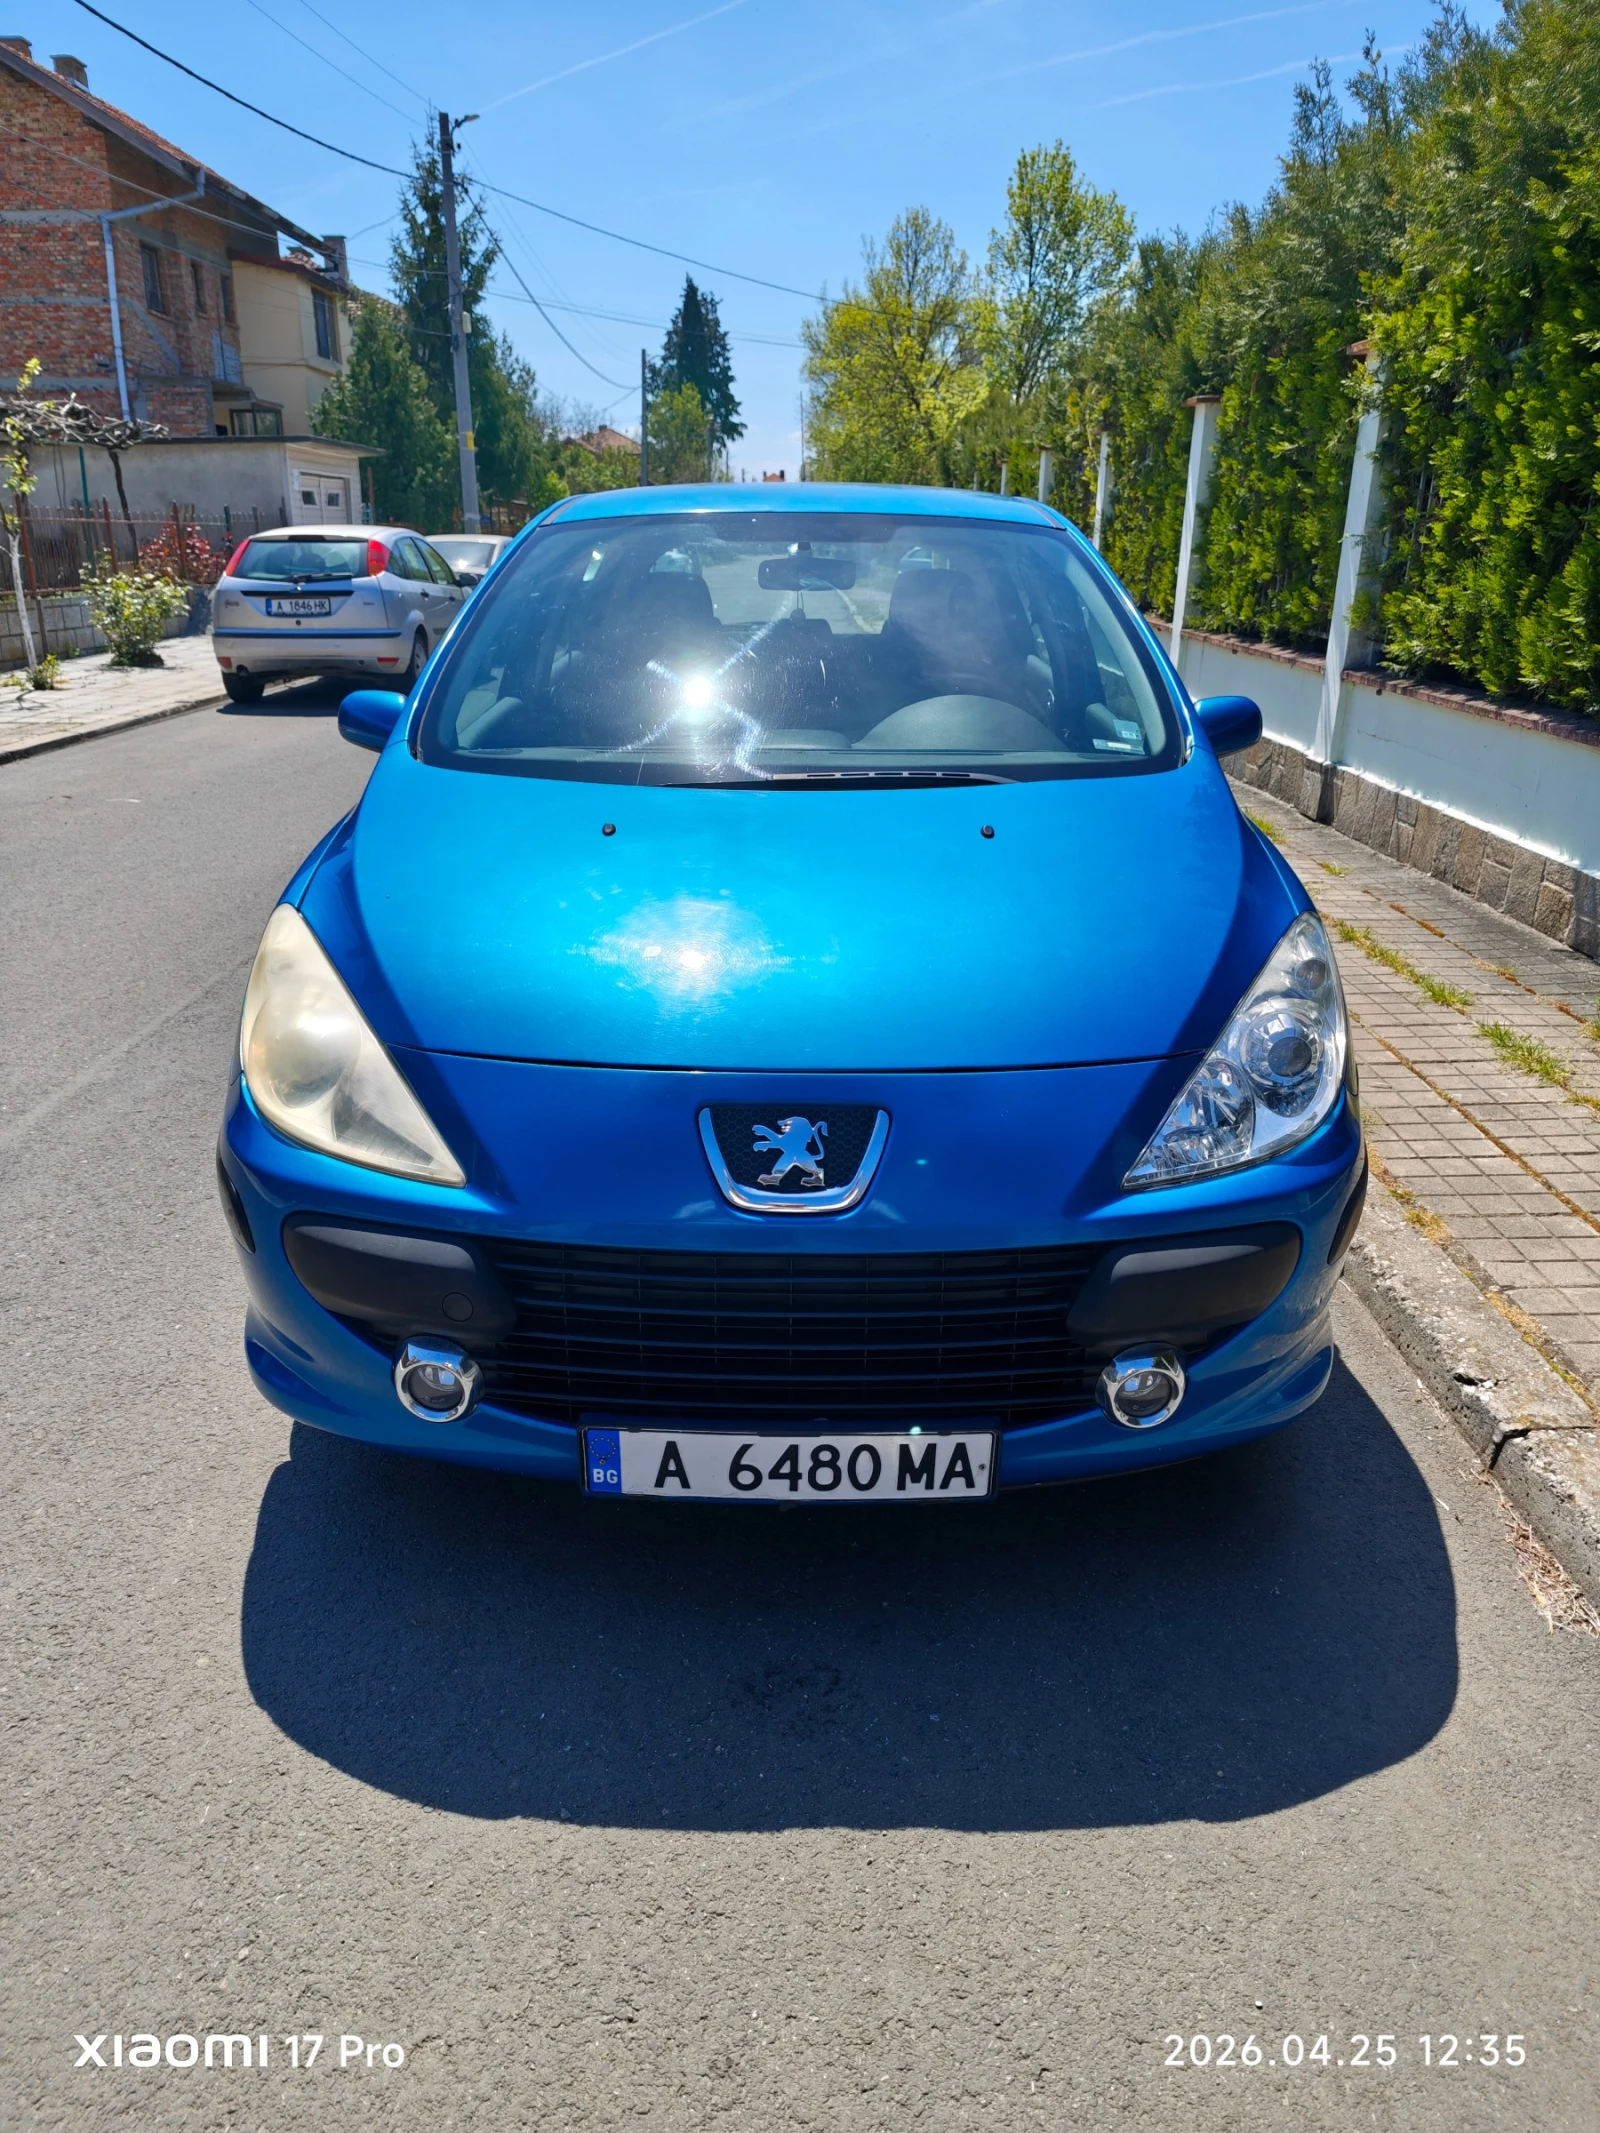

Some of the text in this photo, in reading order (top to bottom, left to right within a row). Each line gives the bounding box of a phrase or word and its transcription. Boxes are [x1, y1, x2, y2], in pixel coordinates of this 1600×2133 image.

[277, 601, 283, 611] A
[290, 601, 312, 611] 1846
[314, 600, 327, 611] HK
[654, 1440, 976, 1493] A 6480 MA
[592, 1468, 618, 1484] BG
